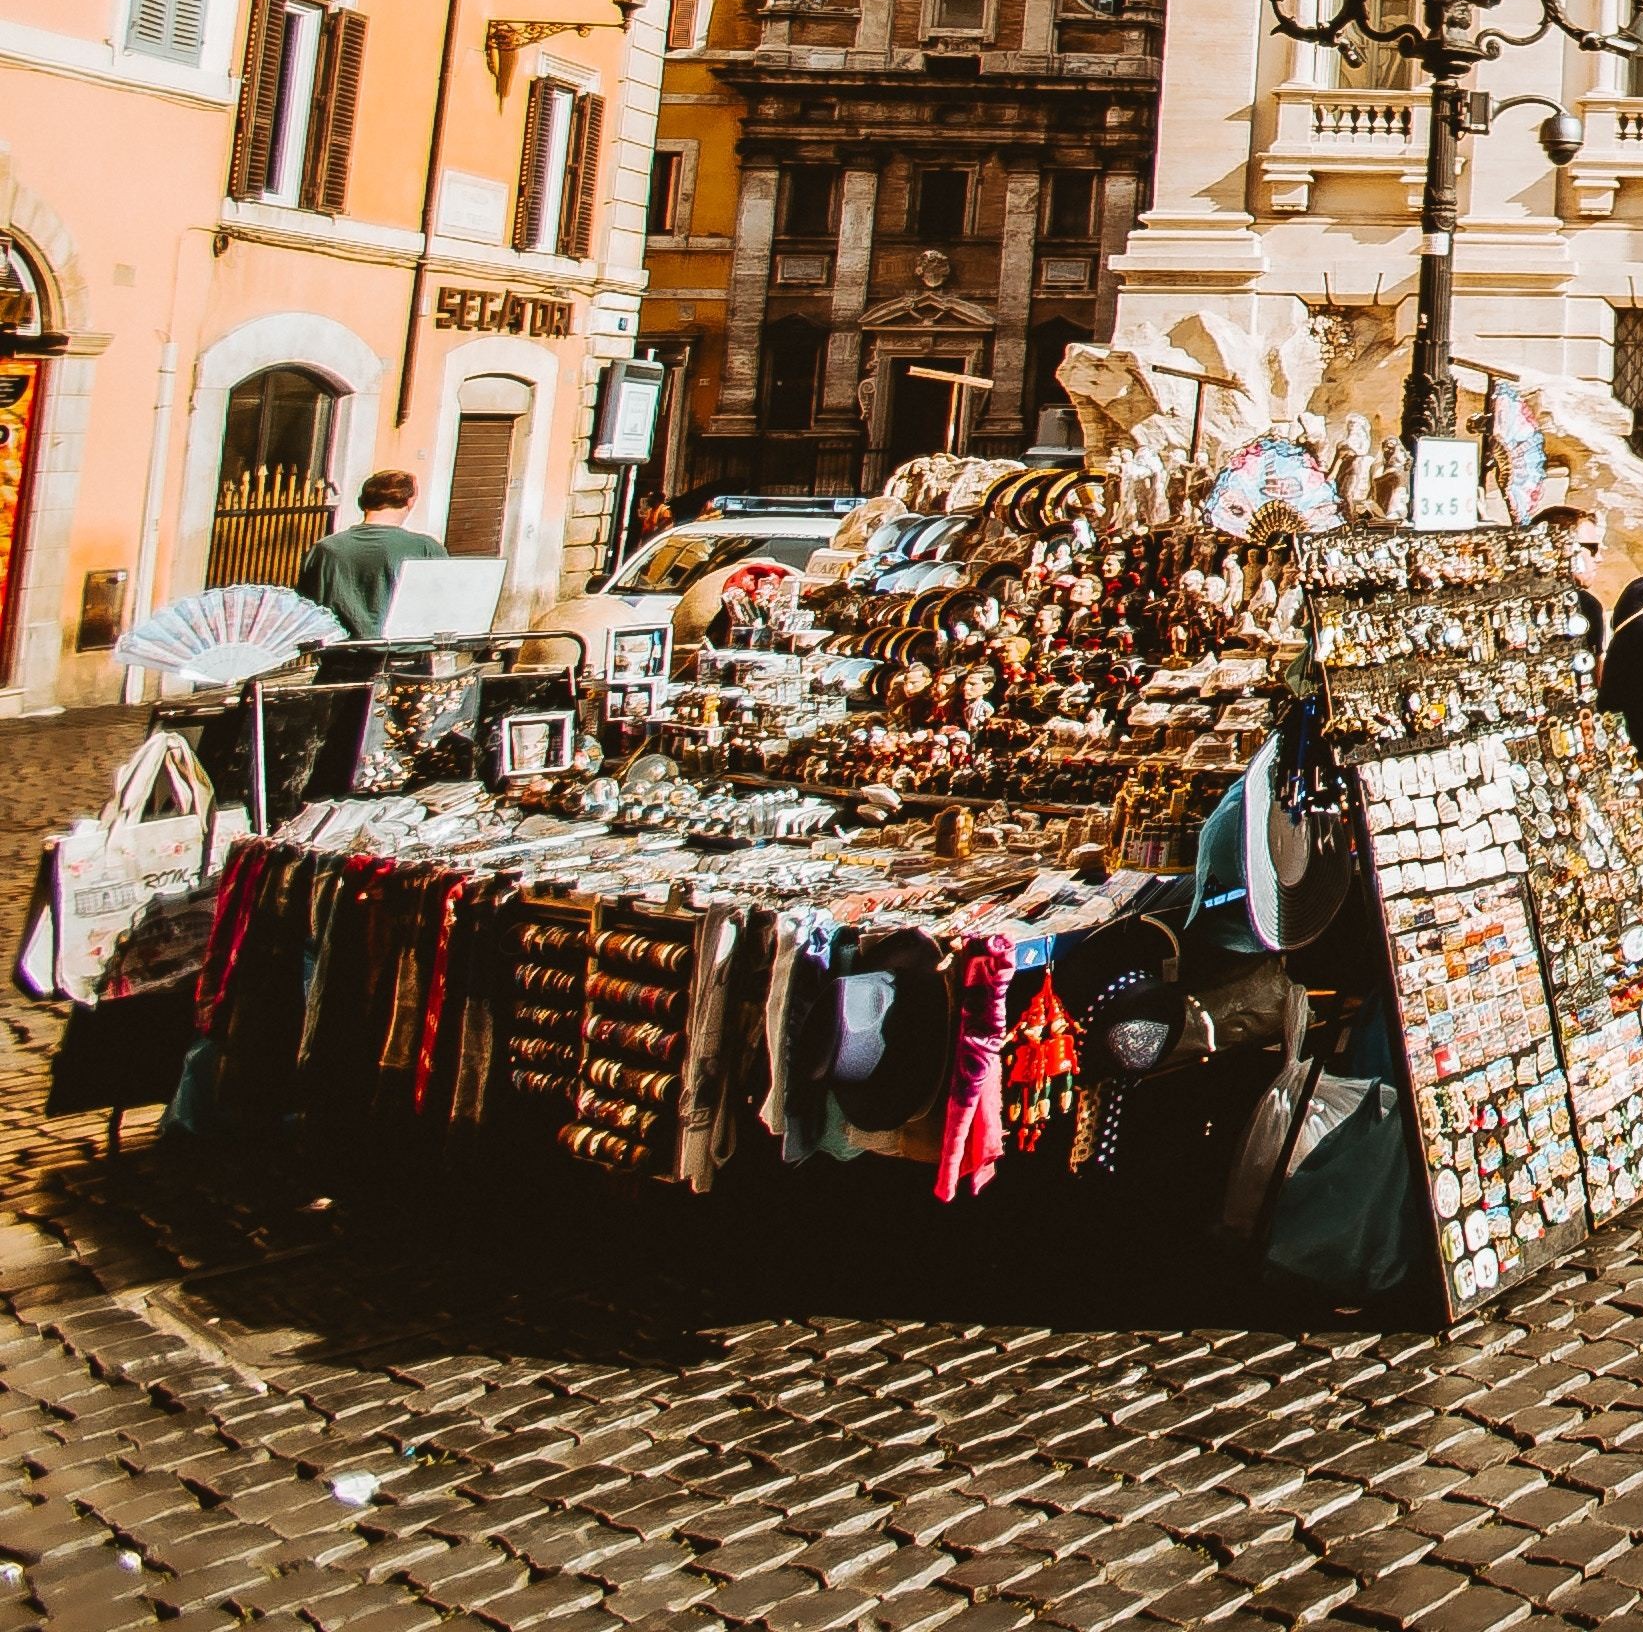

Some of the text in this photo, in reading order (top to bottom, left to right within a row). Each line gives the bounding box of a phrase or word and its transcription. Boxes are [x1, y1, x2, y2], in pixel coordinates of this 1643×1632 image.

[1424, 459, 1430, 477] 1
[1449, 460, 1458, 477] 2
[1421, 497, 1429, 515] 3
[1449, 497, 1458, 515] 5
